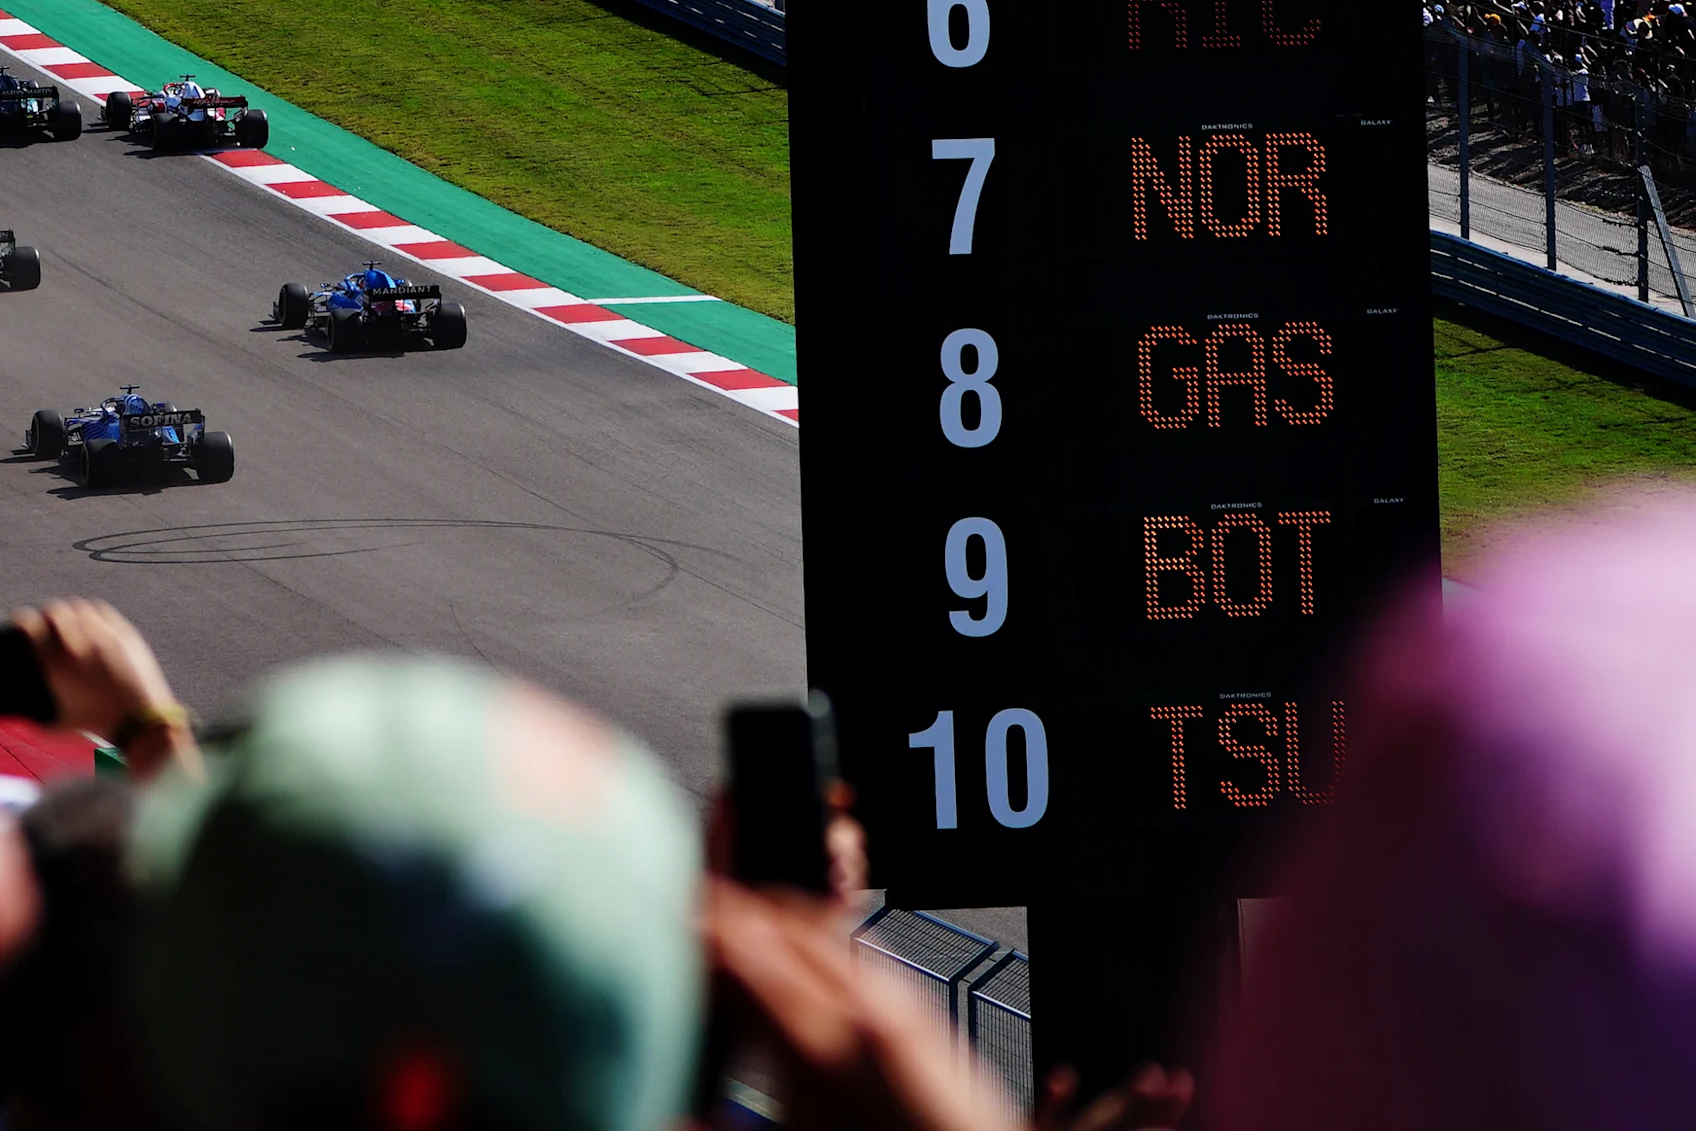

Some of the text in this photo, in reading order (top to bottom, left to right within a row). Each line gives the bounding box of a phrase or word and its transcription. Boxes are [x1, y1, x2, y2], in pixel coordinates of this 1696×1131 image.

[1201, 123, 1254, 131] DAKTRONICS
[932, 133, 1327, 254] 7 NOR
[372, 286, 432, 296] MANDIANT
[1206, 312, 1259, 320] DAKTRONICS
[940, 322, 1333, 447] 8 GAS
[129, 412, 192, 427] SOFINA
[1210, 502, 1263, 510] DAKTRONICS
[945, 511, 1330, 636] 9 BOT
[909, 700, 1346, 828] 10 TSU
